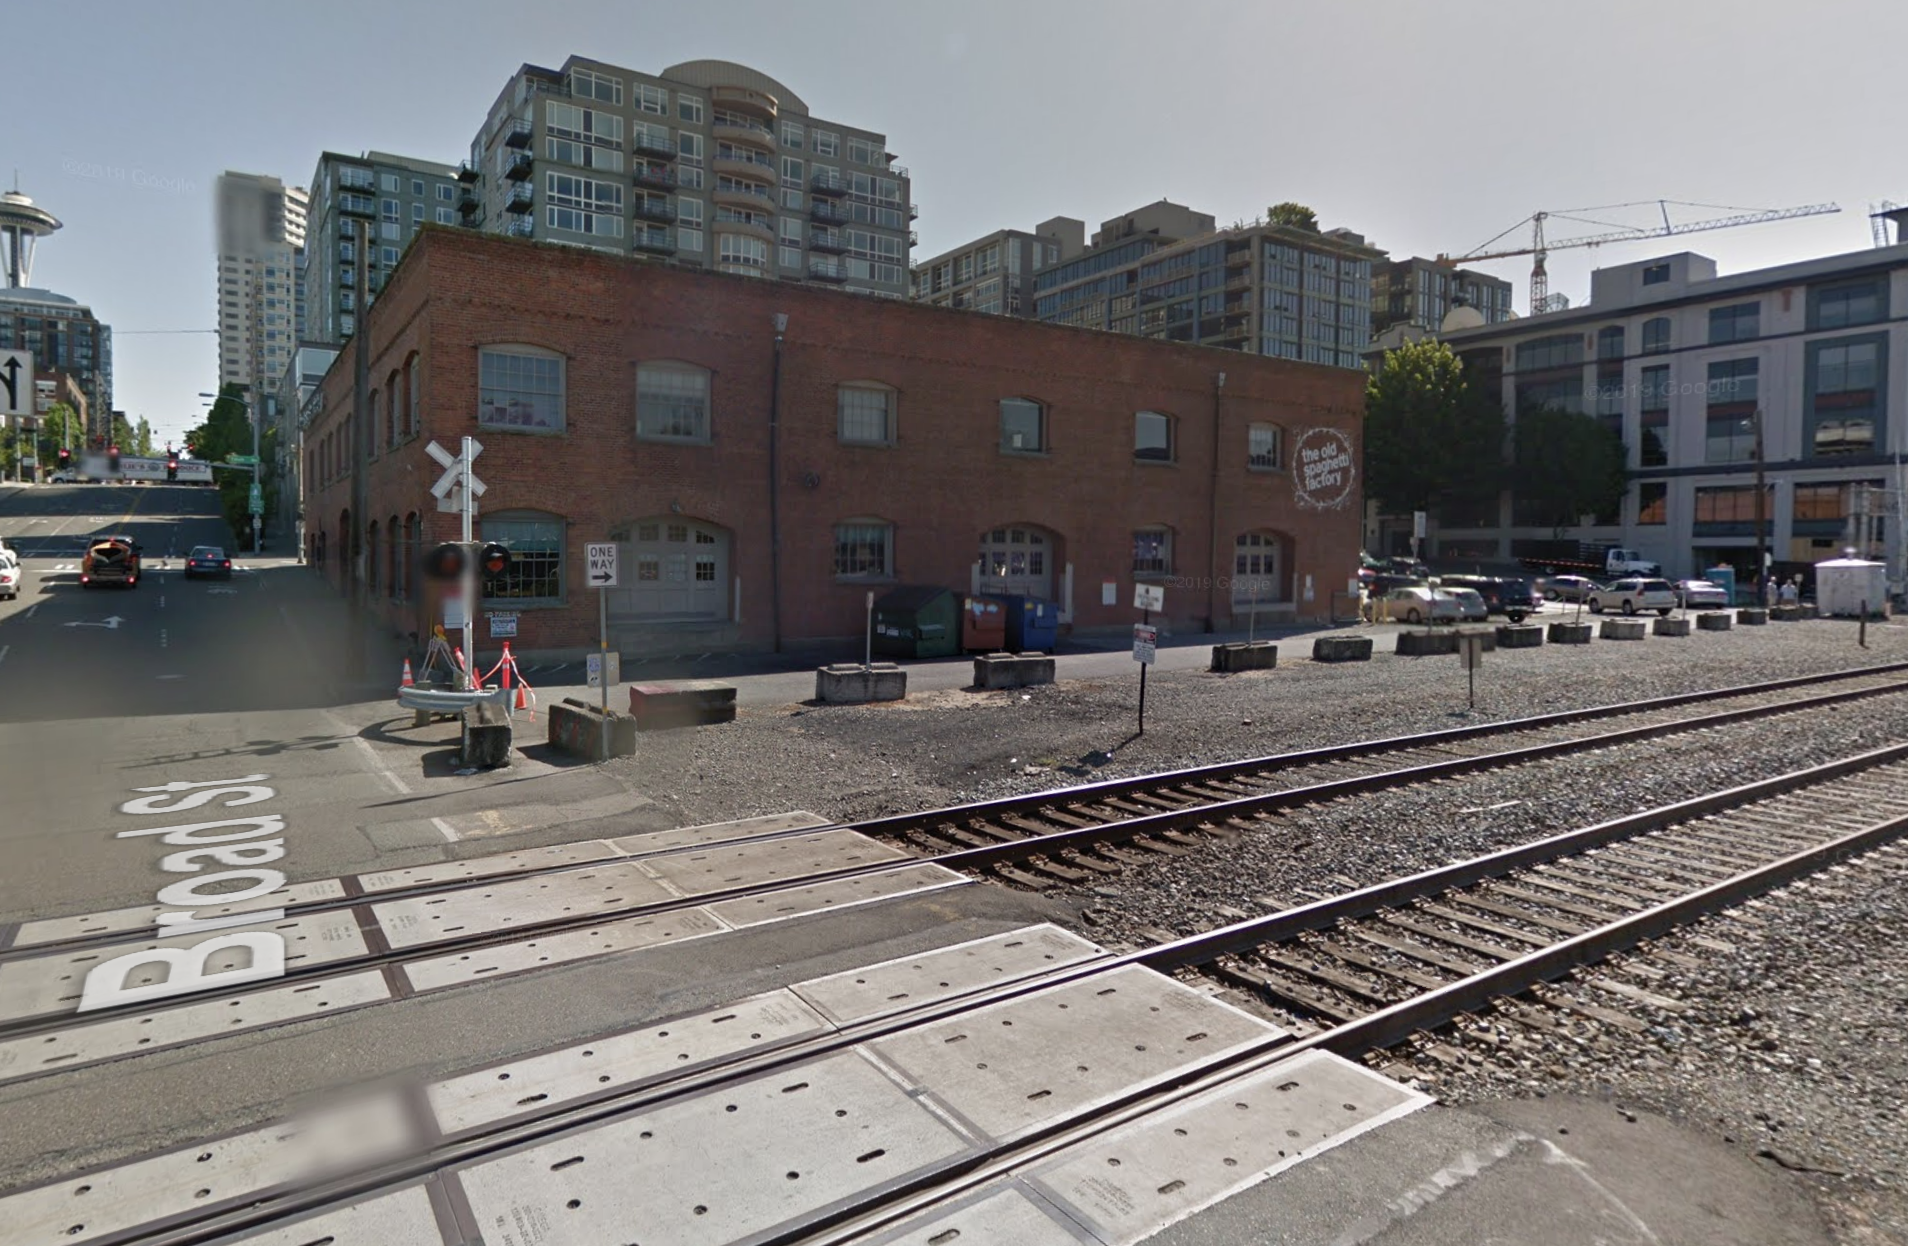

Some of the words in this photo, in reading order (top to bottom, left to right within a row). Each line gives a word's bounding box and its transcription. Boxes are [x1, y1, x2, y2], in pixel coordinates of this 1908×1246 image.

[1301, 446, 1320, 463] the
[1320, 441, 1337, 459] old
[1303, 451, 1350, 478] spaghetti
[1305, 471, 1342, 491] factory
[590, 546, 614, 558] ONE
[590, 558, 615, 570] WAY
